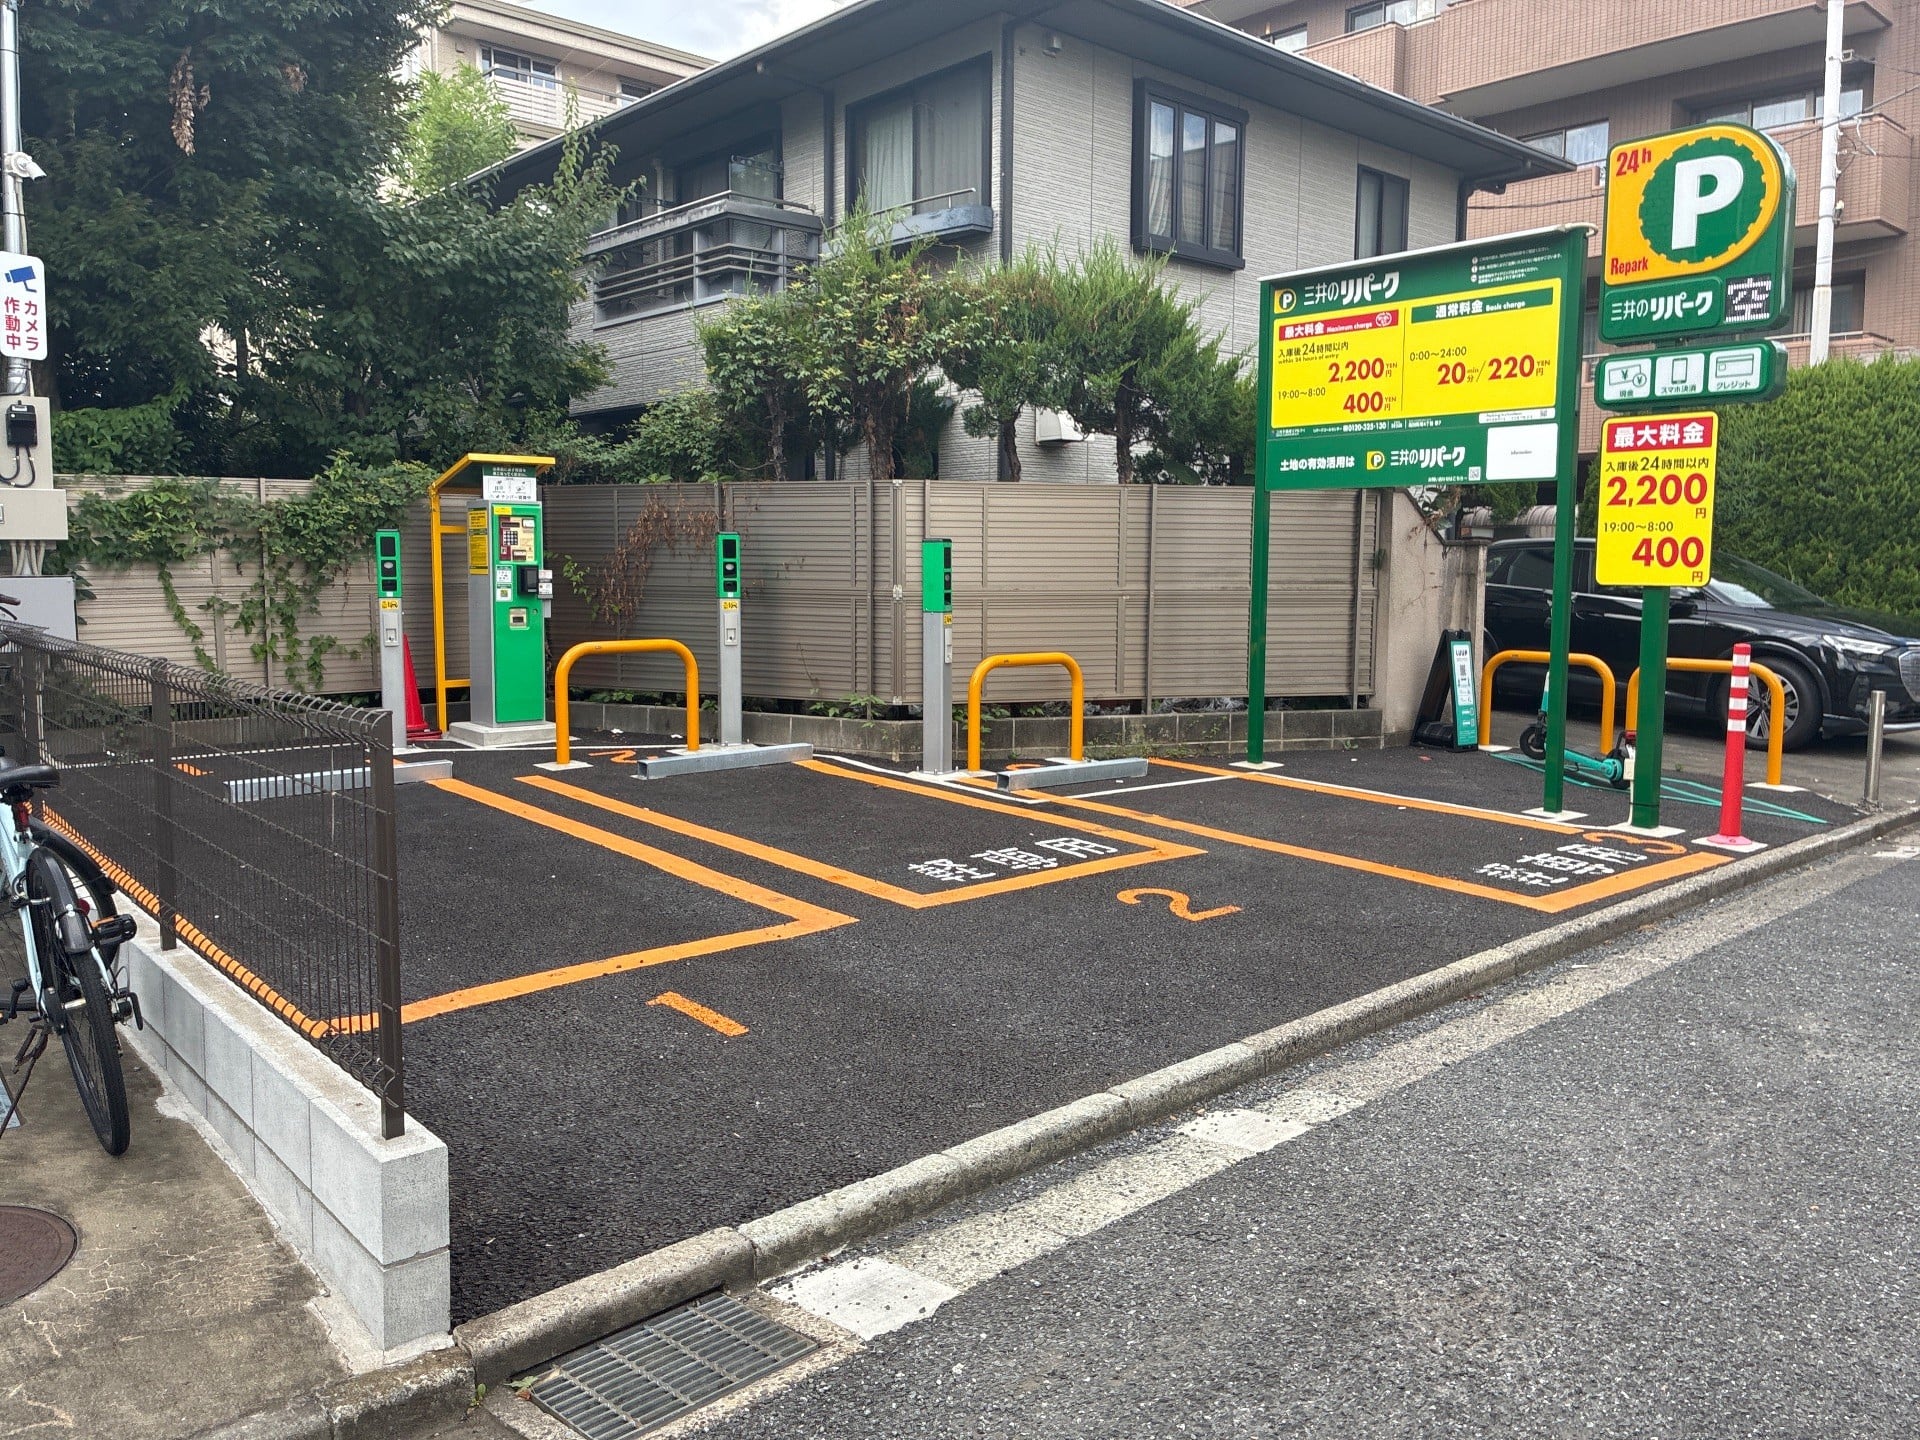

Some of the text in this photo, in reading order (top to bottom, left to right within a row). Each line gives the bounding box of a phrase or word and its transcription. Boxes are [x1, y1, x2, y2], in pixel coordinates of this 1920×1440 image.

[1671, 155, 1744, 250] P
[1610, 256, 1649, 276] Repark
[1303, 271, 1400, 306] 三井のリパーク
[1282, 292, 1293, 309] P
[1435, 299, 1483, 319] 通常料金
[1503, 300, 1526, 310] charge
[1610, 290, 1713, 321] 三井のリパーク
[4, 296, 21, 350] 作動中
[24, 300, 39, 351] カメラ
[1284, 321, 1325, 339] 最大料金
[1353, 322, 1373, 330] charge
[1278, 341, 1349, 358] 入庫後24時間以内
[1328, 357, 1385, 383] 2,200
[1385, 369, 1392, 378] 円
[1437, 362, 1466, 386] 20
[1488, 354, 1535, 381] 220
[1619, 389, 1634, 398] 現金
[1660, 385, 1697, 394] スマホ決済
[1716, 380, 1751, 390] クレジット
[1343, 391, 1384, 414] 400
[1384, 402, 1391, 411] 円
[1613, 421, 1705, 448] 最大料金
[1279, 455, 1355, 472] 土地の有効活用は
[1390, 445, 1466, 468] 三井のリパーク
[1605, 456, 1709, 473] 入庫後24時間以内
[1606, 472, 1708, 508] 2,200
[1695, 507, 1707, 519] 円
[1631, 536, 1705, 568] 400
[1692, 570, 1704, 583] 円
[1583, 832, 1688, 855] 3
[908, 837, 1119, 882] 軽専用
[1473, 843, 1647, 887] 軽専用
[1116, 887, 1243, 922] 2
[644, 990, 751, 1037] 1
